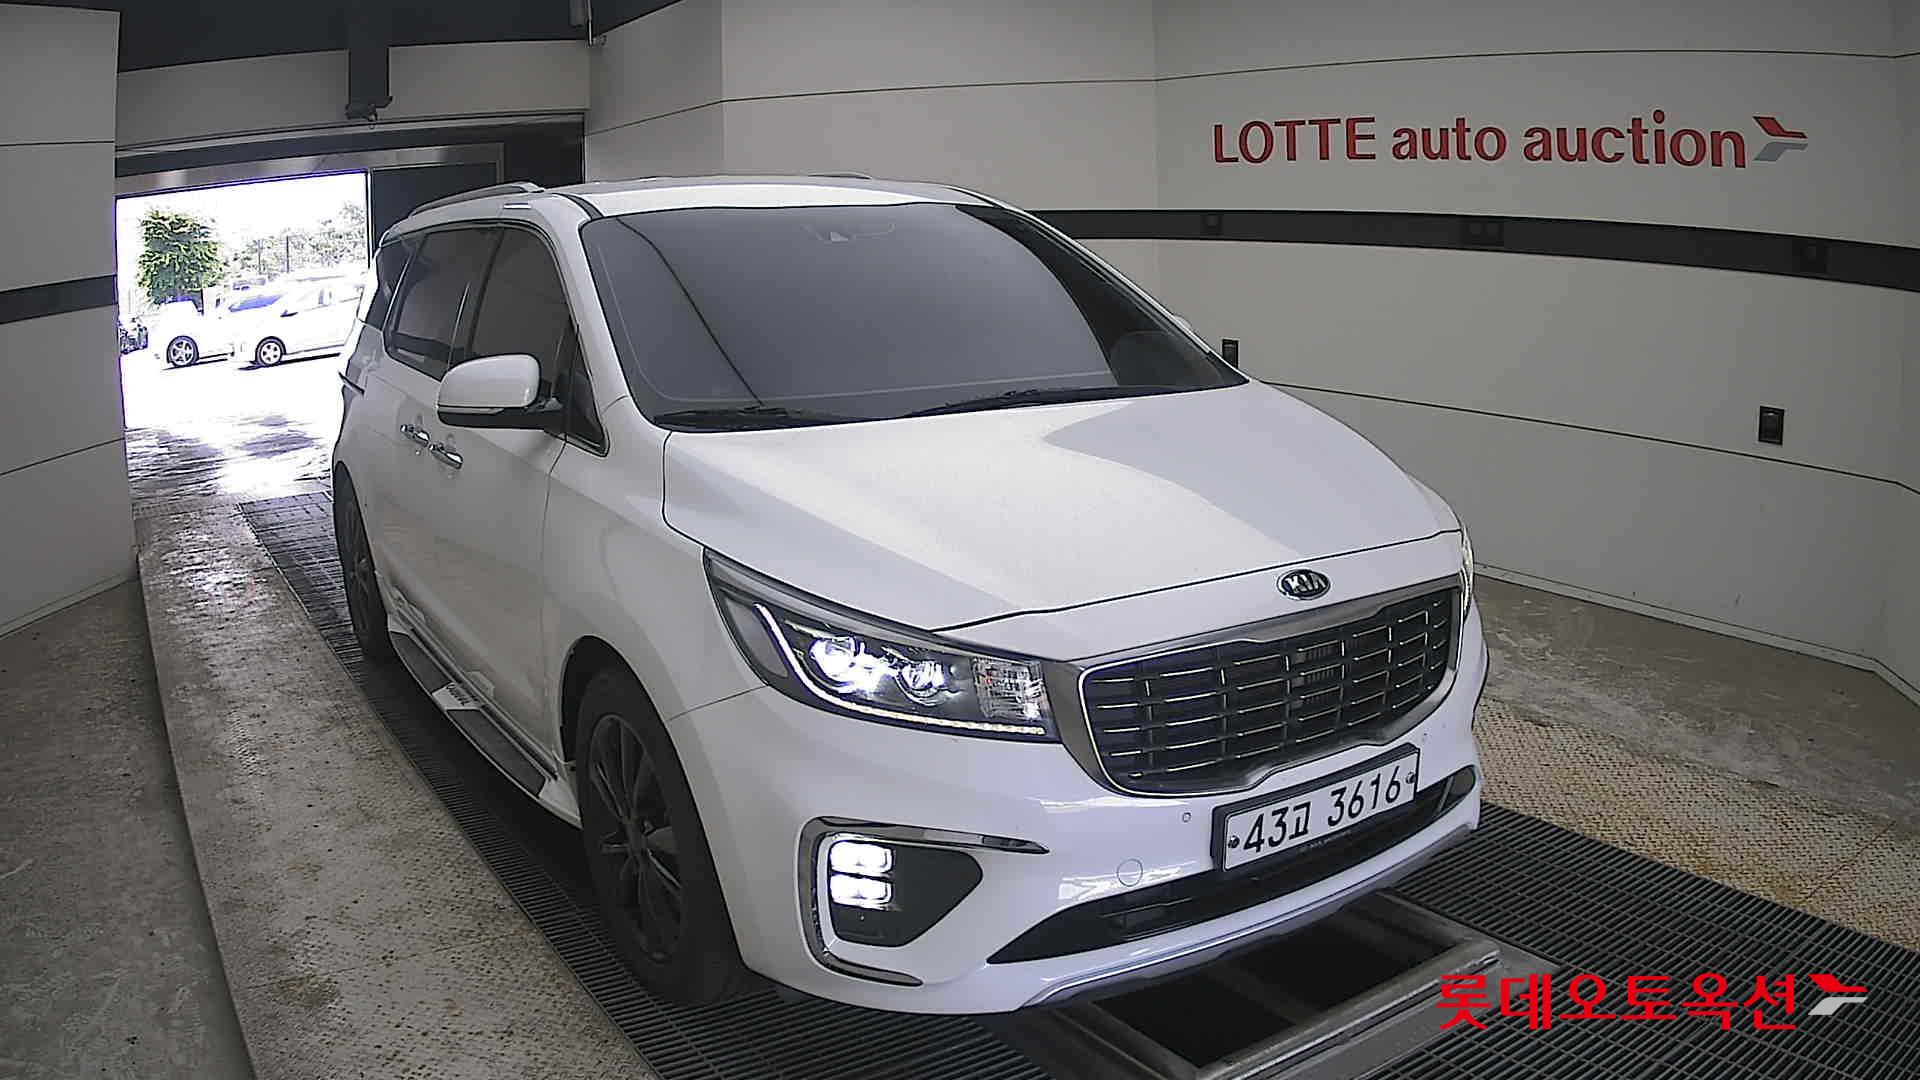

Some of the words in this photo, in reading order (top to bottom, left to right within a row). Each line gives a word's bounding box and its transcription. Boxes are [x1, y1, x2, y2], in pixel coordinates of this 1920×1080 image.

[1213, 117, 1376, 163] LOTTE
[1391, 118, 1508, 161] auto
[1523, 110, 1747, 168] auction
[1283, 573, 1328, 594] KIA
[1243, 801, 1312, 853] 43고
[1327, 765, 1401, 827] 3616
